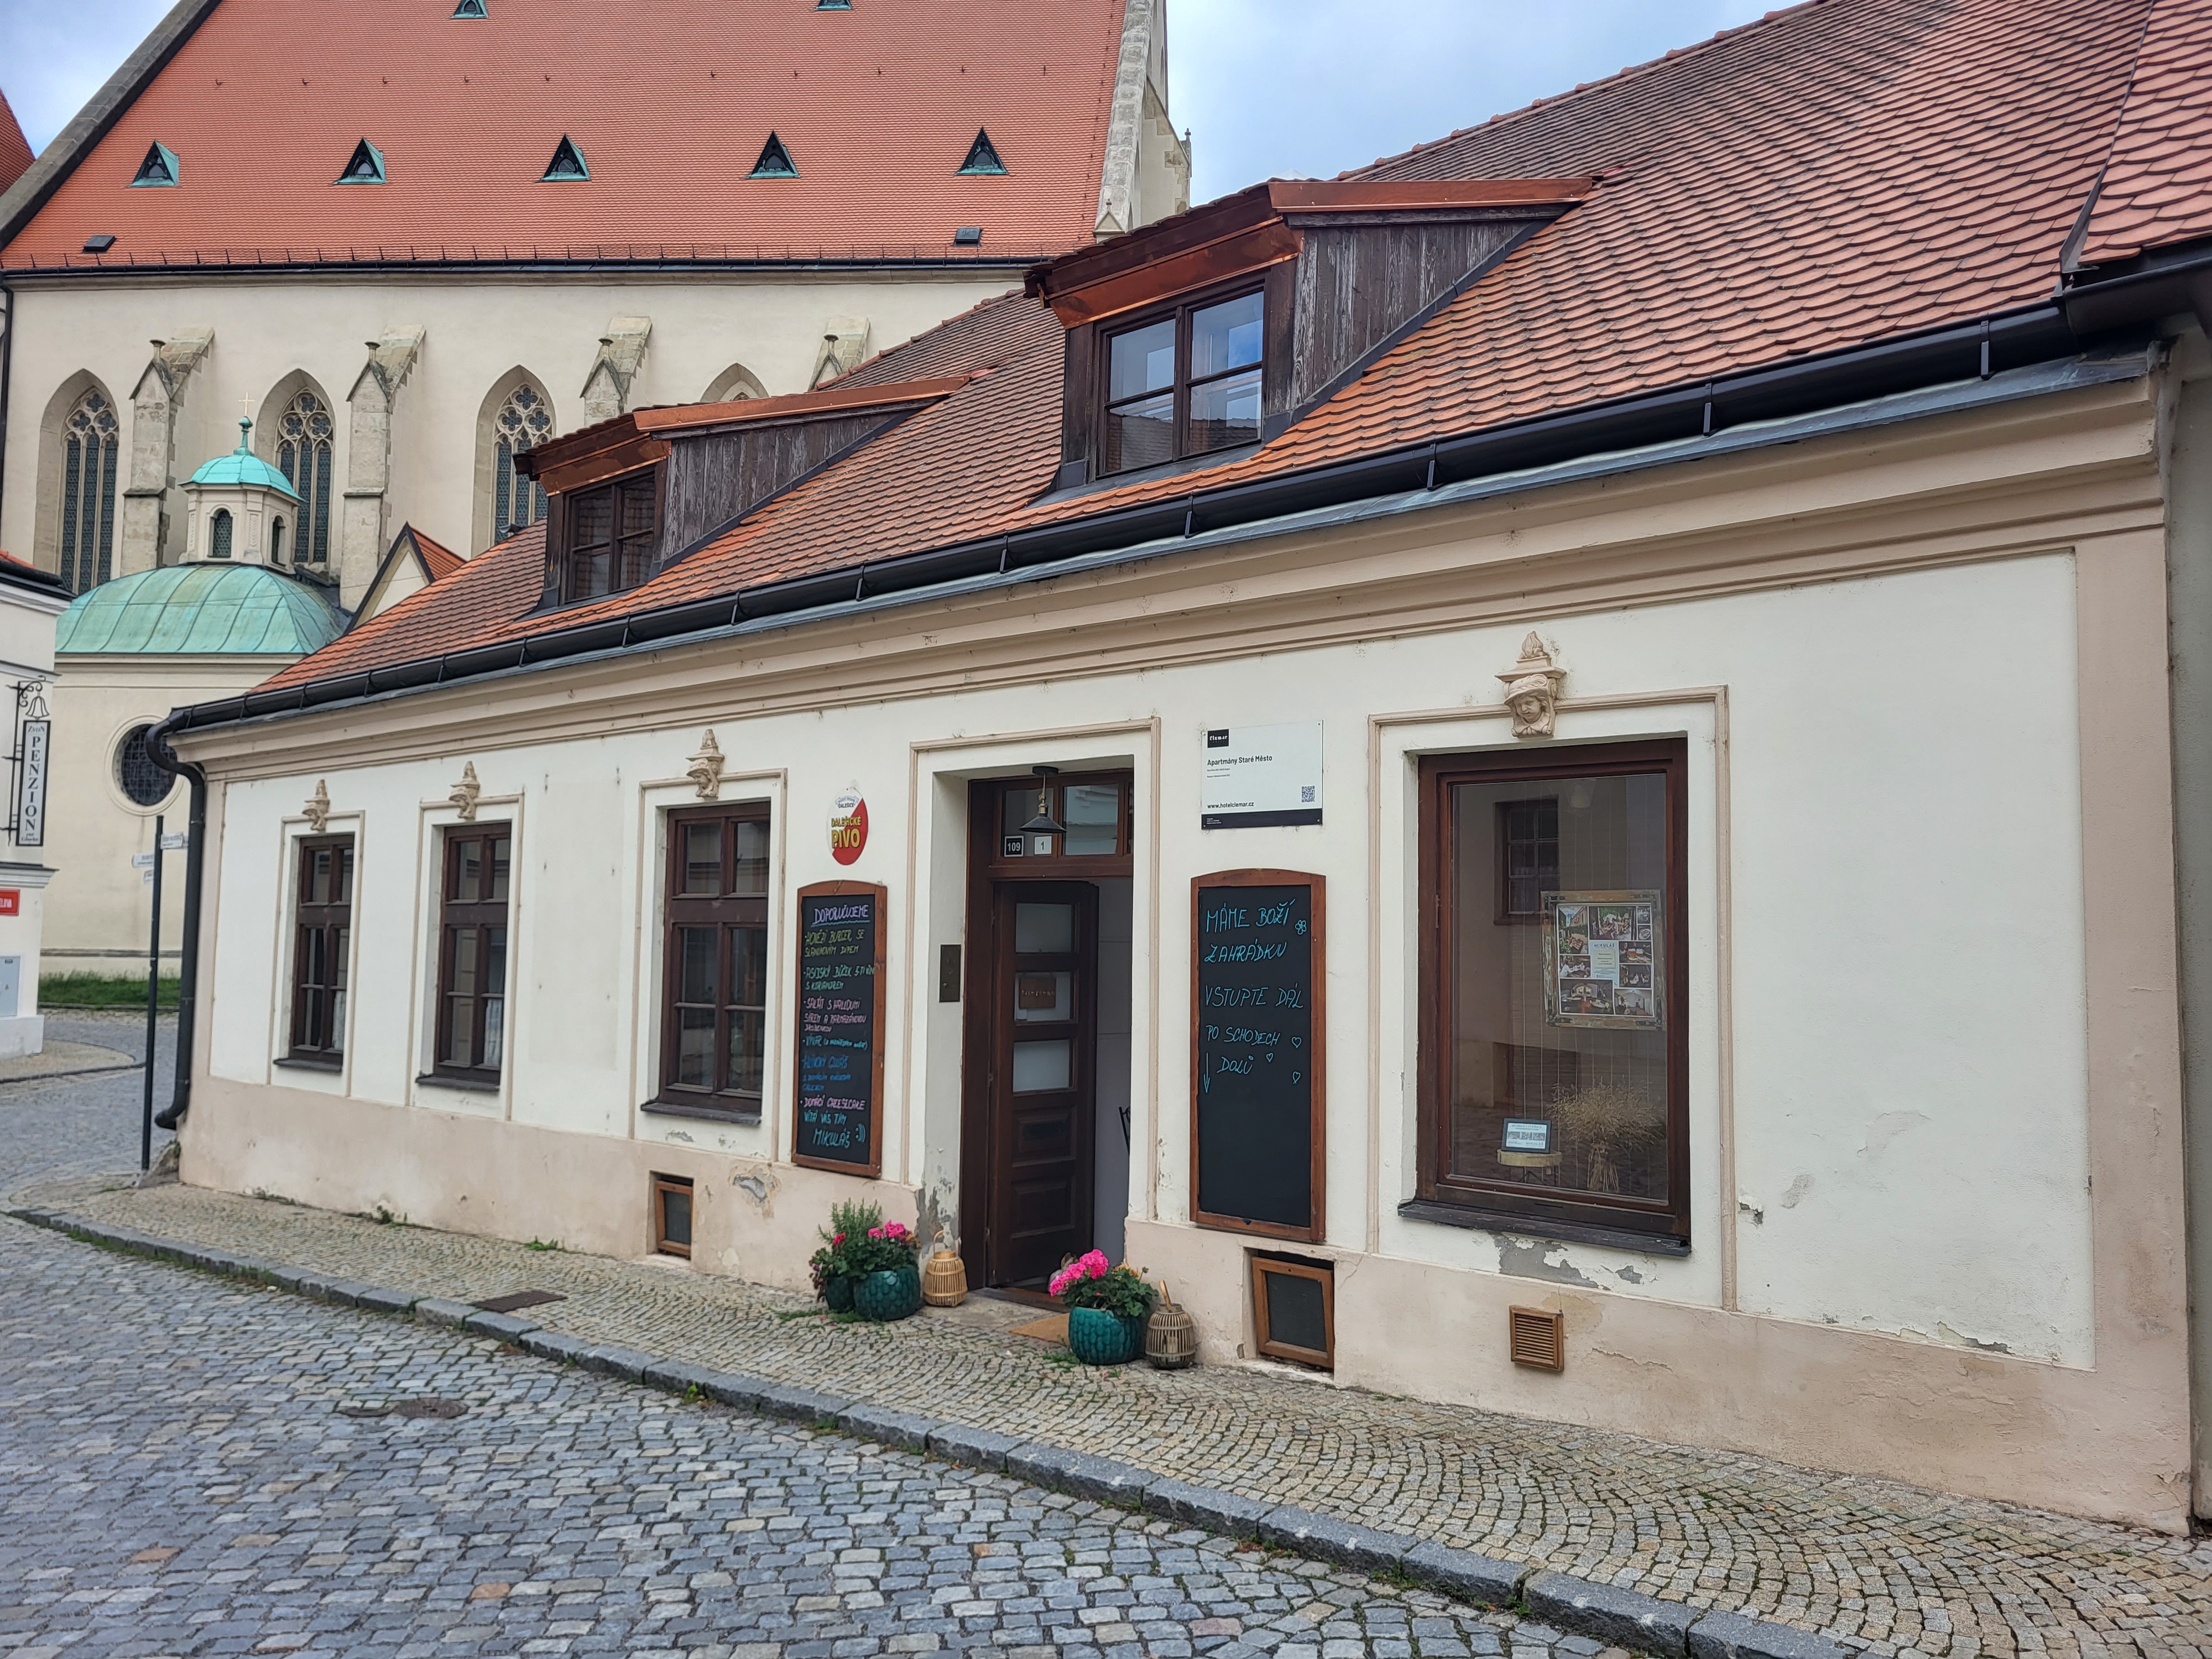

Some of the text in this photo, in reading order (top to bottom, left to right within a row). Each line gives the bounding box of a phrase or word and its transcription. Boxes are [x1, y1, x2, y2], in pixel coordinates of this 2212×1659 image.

[1207, 758, 1238, 767] Apartmány
[25, 736, 41, 832] PENZION
[831, 828, 861, 849] PIVO
[1008, 842, 1021, 852] 109
[1040, 841, 1045, 851] 1
[1206, 898, 1296, 933] MÁME BOŽÍ
[856, 929, 865, 939] SE
[1204, 938, 1287, 963] ZAHRÁDKU
[827, 999, 832, 1010] S
[1205, 982, 1303, 1009] VSTUPTE DÁL
[1206, 1025, 1281, 1047] PO SCHODECH
[1216, 1055, 1254, 1074] DOLŮ
[812, 1128, 851, 1149] MIKULÁŠ
